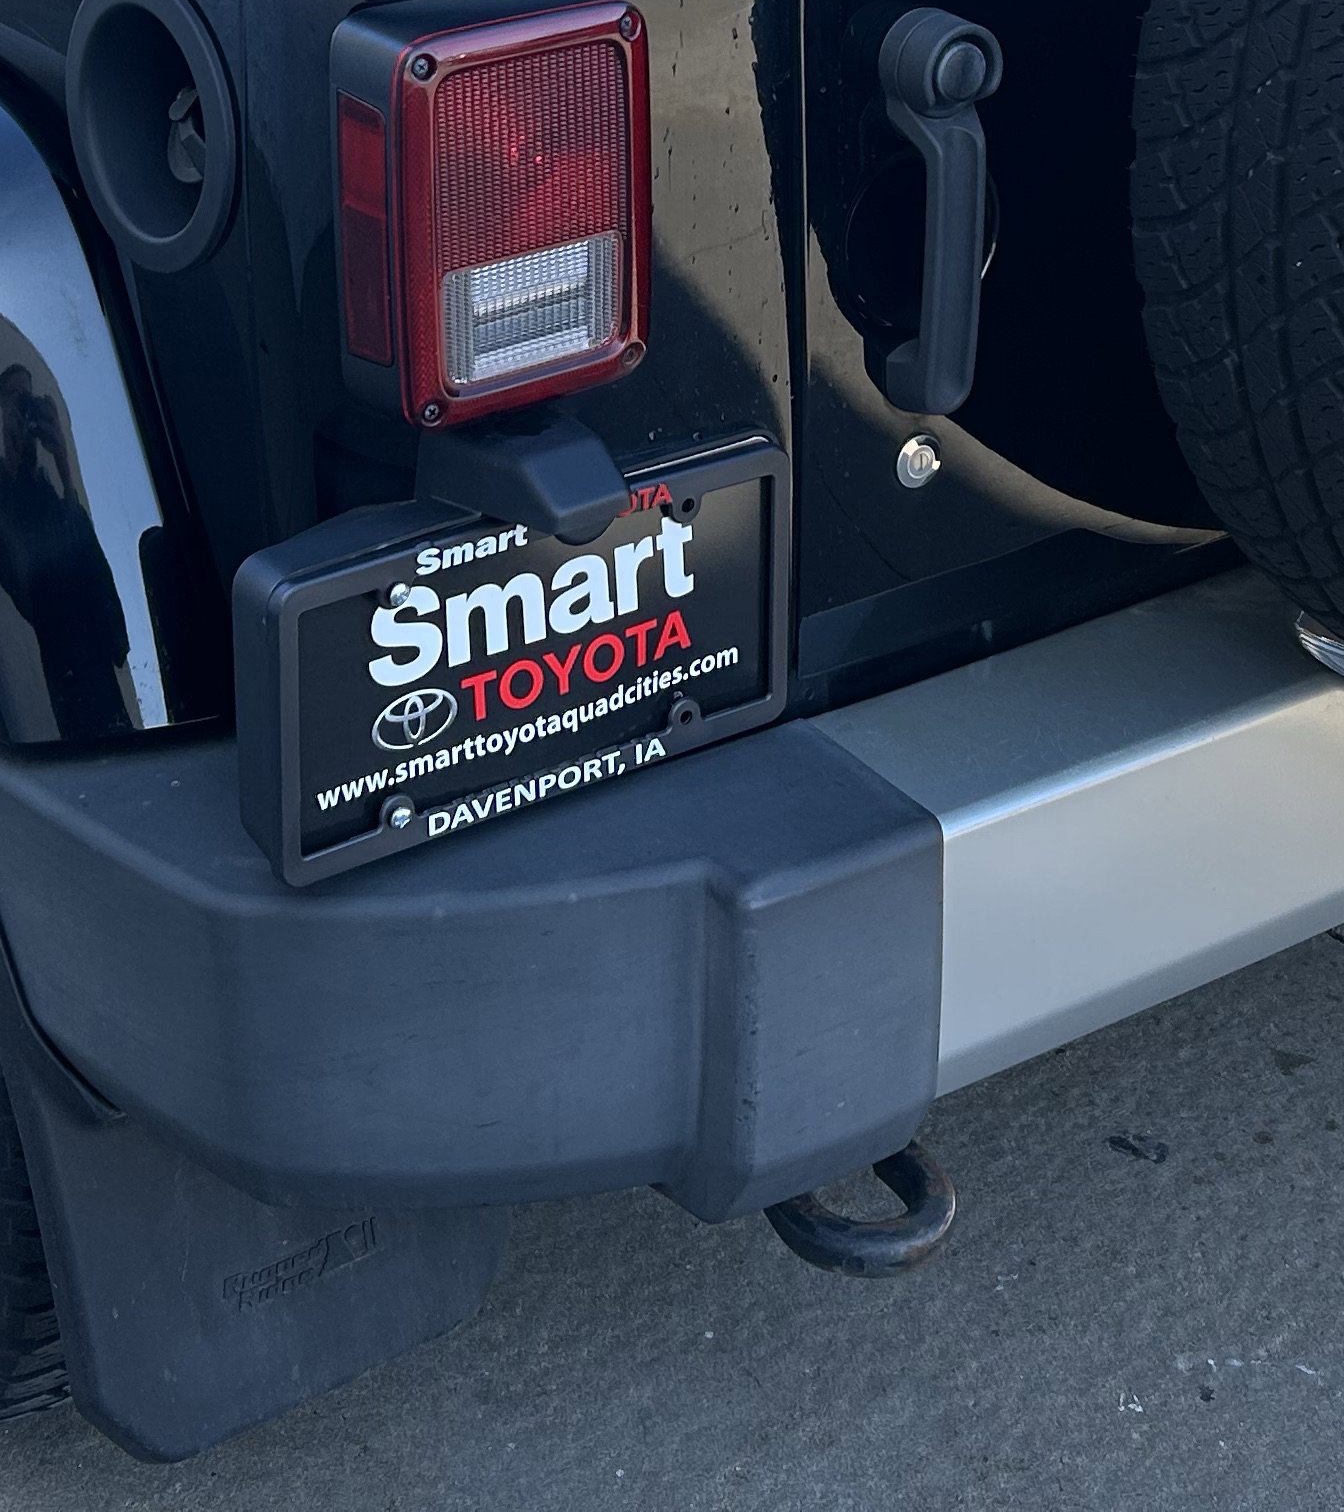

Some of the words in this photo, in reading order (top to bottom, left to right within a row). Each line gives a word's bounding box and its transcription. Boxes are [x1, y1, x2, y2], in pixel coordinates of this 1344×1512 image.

[368, 516, 694, 687] Smart
[415, 523, 529, 577] Smart
[461, 609, 692, 721] TOYOTA
[316, 644, 740, 811] www.smarttoyotaquadcities.com
[427, 749, 627, 837] DAVENPORT,
[634, 737, 668, 766] IA
